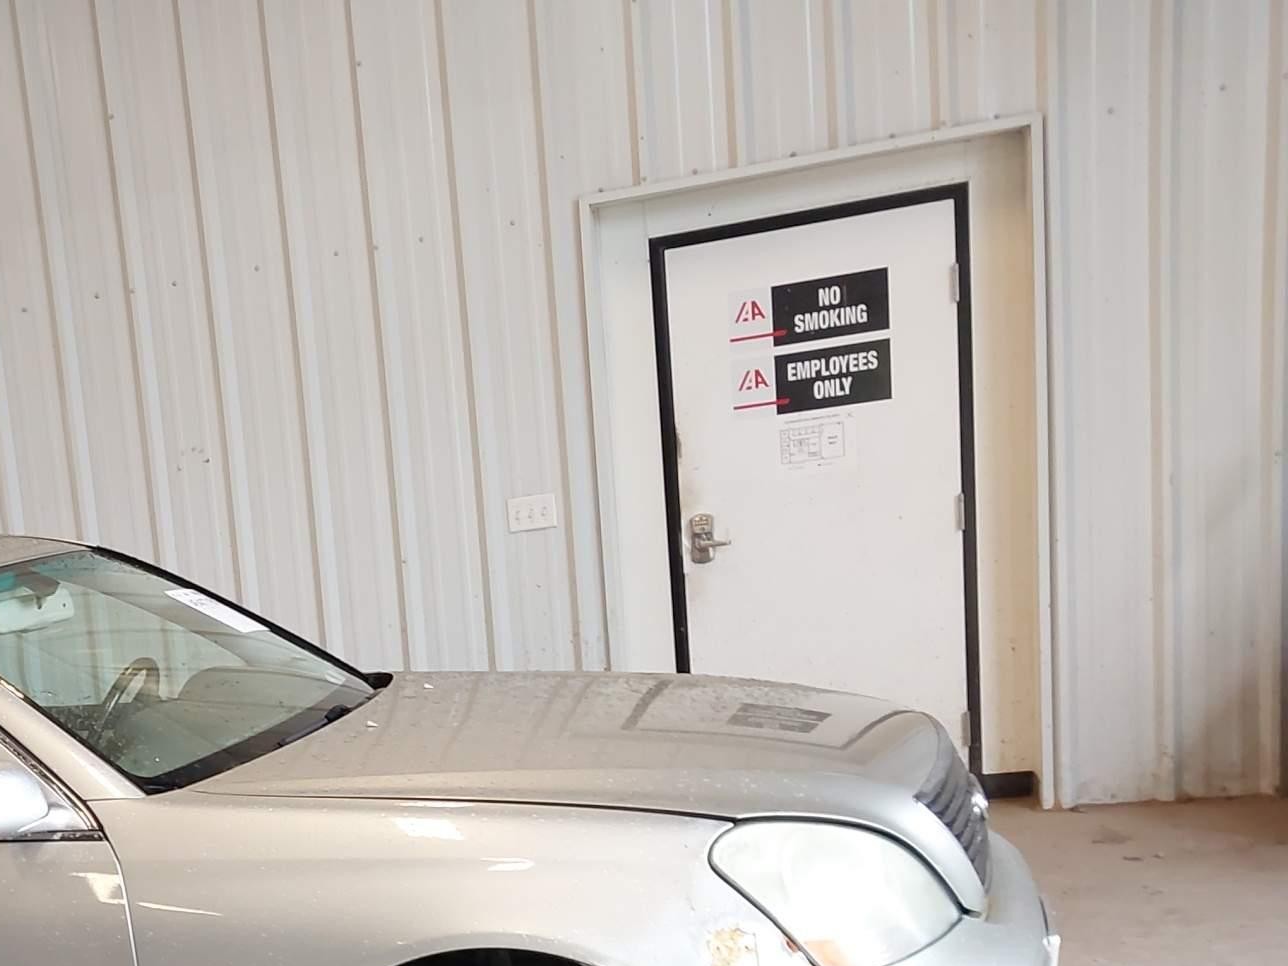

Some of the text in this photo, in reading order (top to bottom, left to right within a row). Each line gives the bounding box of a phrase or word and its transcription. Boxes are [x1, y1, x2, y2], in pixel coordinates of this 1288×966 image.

[818, 285, 841, 307] NO
[794, 304, 868, 333] SMOKING
[787, 350, 878, 381] EMPLOYEES
[813, 376, 853, 400] ONLY
